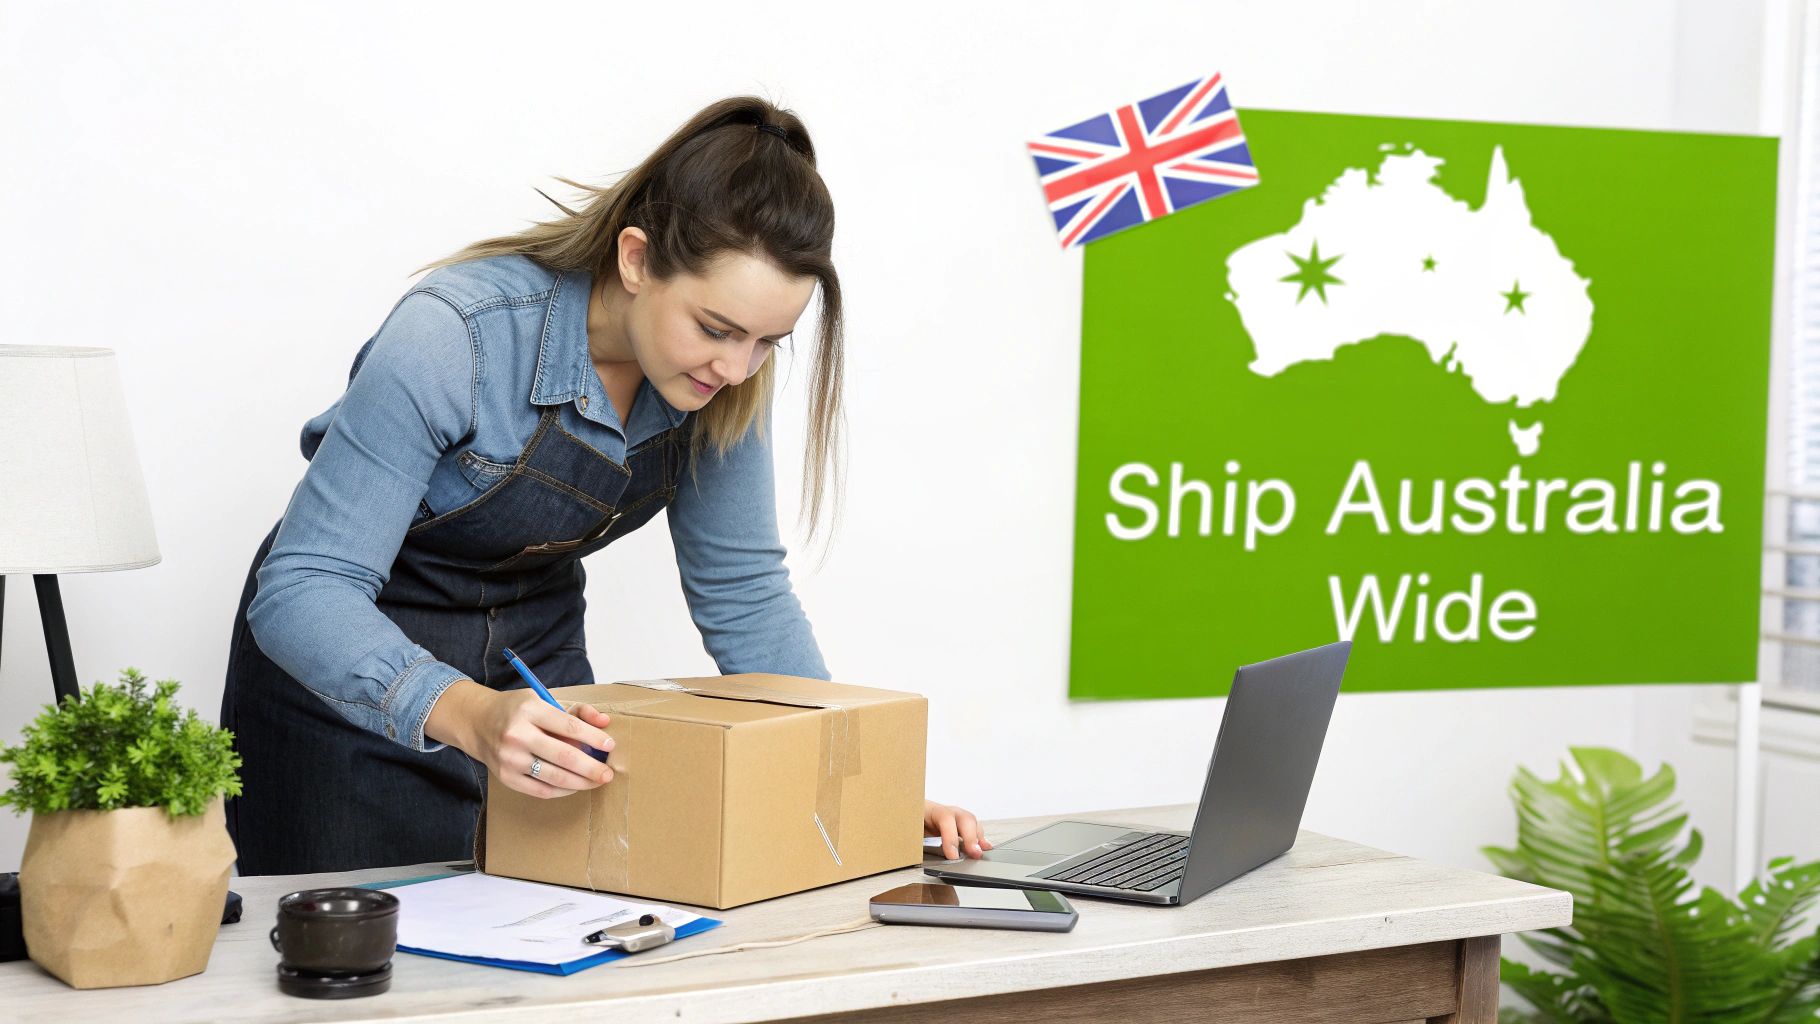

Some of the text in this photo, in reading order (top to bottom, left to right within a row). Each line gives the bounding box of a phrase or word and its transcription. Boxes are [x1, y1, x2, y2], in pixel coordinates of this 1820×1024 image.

[1105, 460, 1725, 551] Ship Australia
[1328, 573, 1538, 643] Wide
